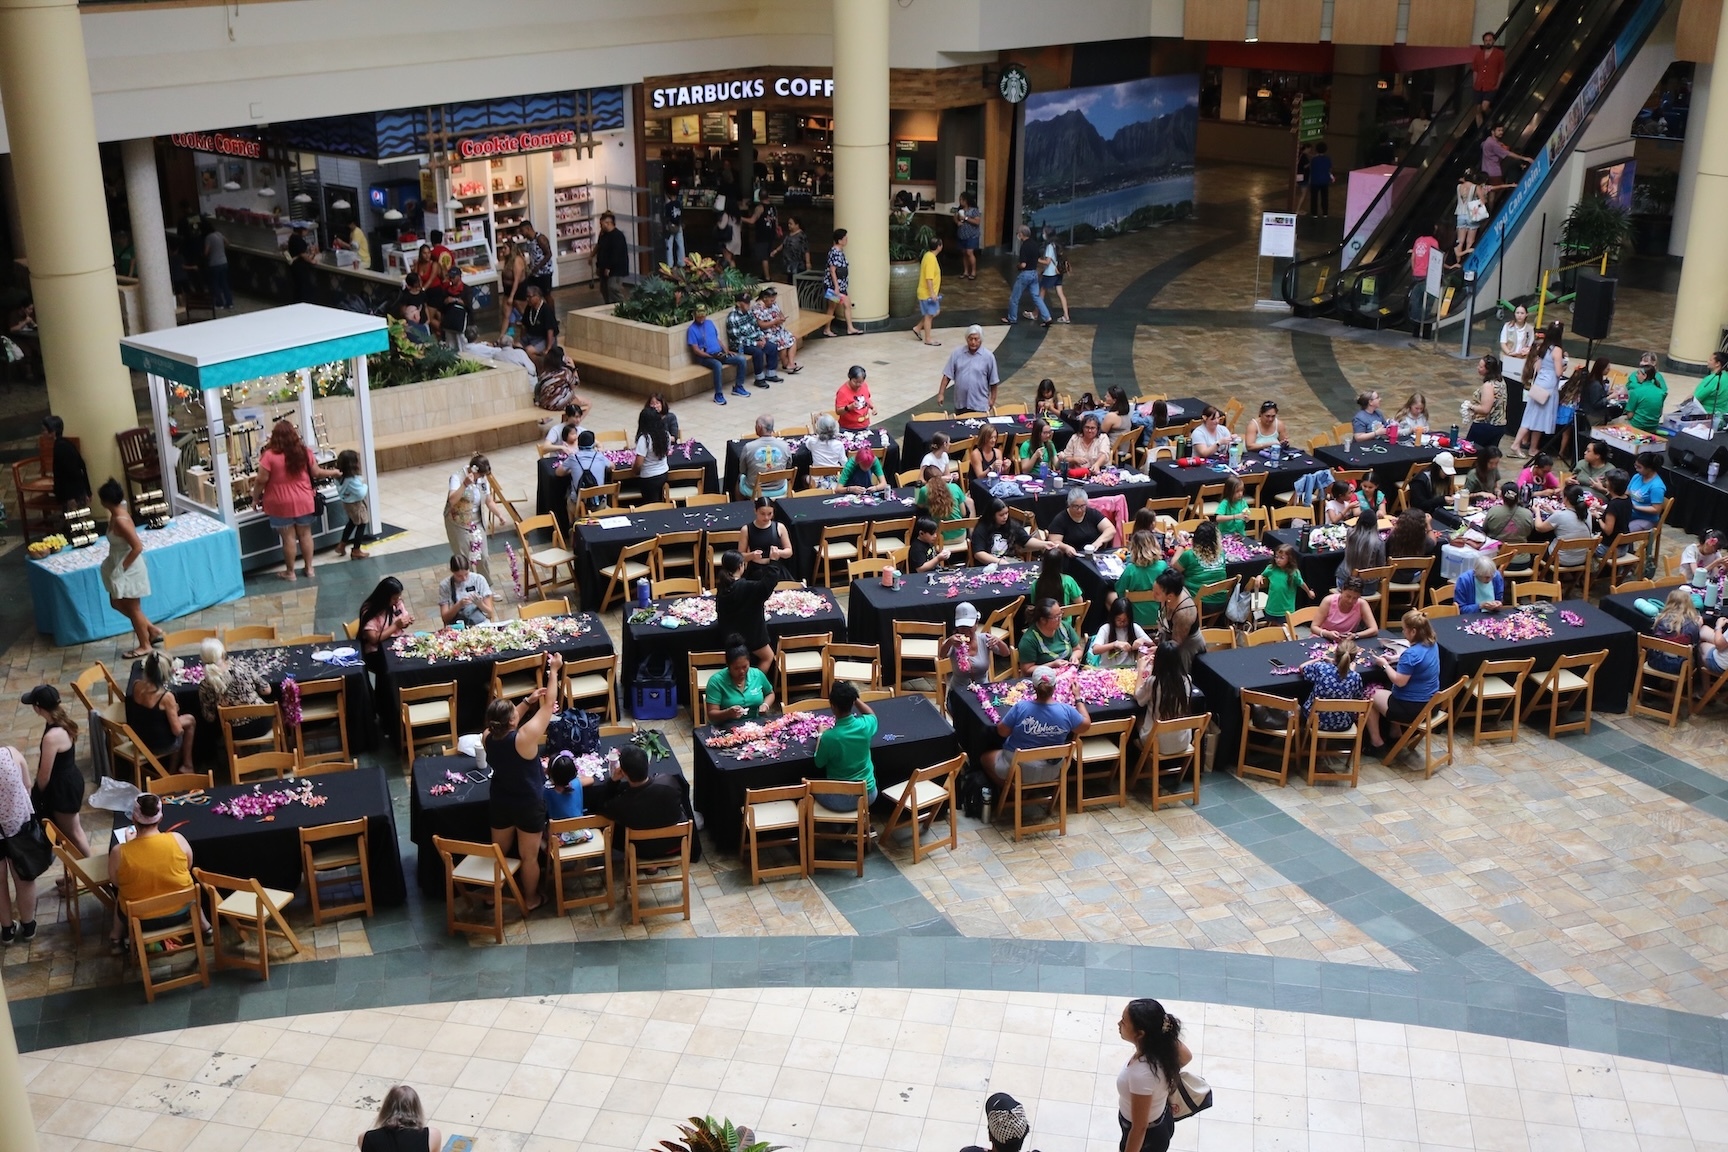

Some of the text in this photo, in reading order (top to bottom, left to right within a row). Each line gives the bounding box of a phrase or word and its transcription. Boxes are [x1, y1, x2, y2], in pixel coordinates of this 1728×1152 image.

[653, 79, 765, 109] STARBUCKS
[170, 132, 261, 159] Cookie Corner
[461, 131, 575, 157] Cookie Corner
[1494, 160, 1541, 235] You Can Join!
